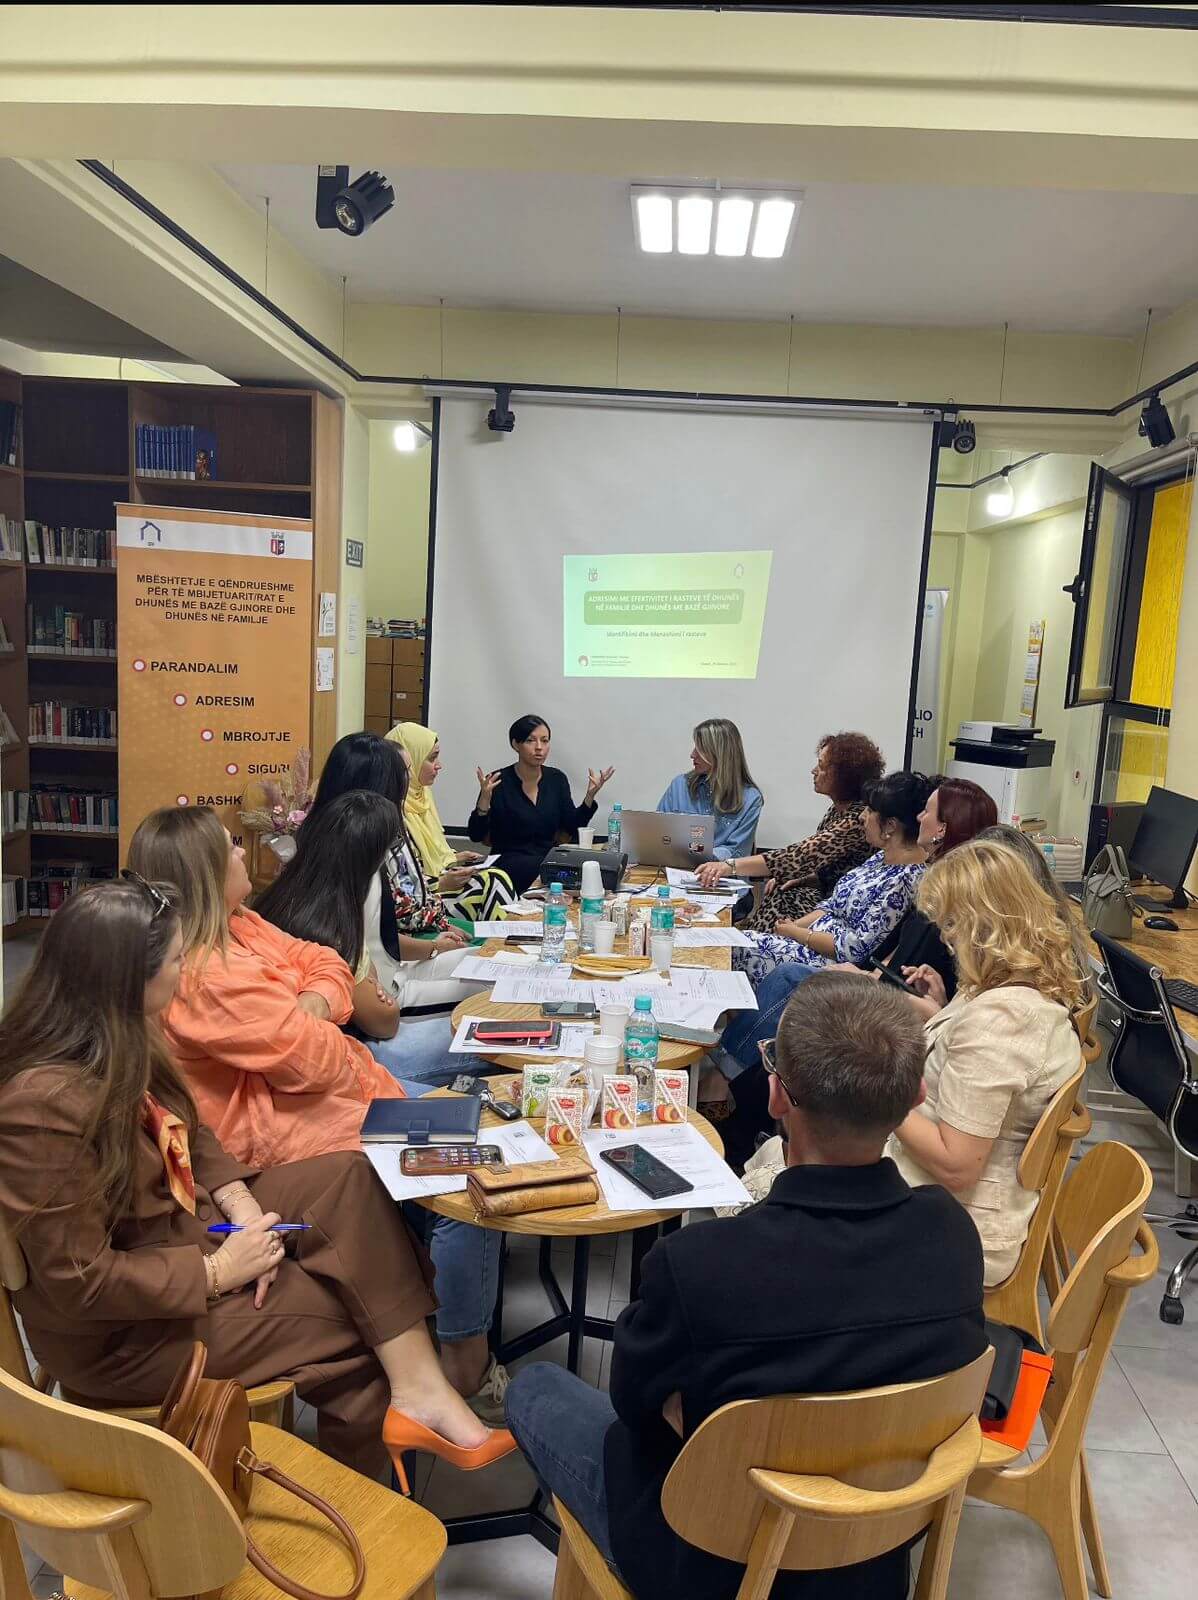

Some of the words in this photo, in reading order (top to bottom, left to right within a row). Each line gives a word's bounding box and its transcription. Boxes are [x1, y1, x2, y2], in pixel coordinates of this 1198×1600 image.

[347, 541, 362, 560] EXIT
[136, 574, 206, 587] MBËSHTETJE
[208, 578, 215, 587] E
[218, 578, 295, 592] QËNDRUESHME
[147, 586, 169, 596] PËR
[171, 587, 185, 597] TË
[187, 589, 276, 602] MBIJETUARIT/RAT
[278, 594, 285, 602] E
[135, 597, 179, 608] DHUNËS
[182, 600, 197, 609] ME
[200, 601, 227, 611] BAZË
[230, 603, 273, 613] GJINORE
[275, 605, 296, 614] DHE
[165, 611, 208, 621] DHUNËS
[211, 613, 225, 622] NË
[227, 614, 269, 624] FAMILJE
[150, 661, 239, 674] PARANDALIM
[195, 695, 256, 707] ADRESIM
[223, 731, 291, 742] MBROJTJE
